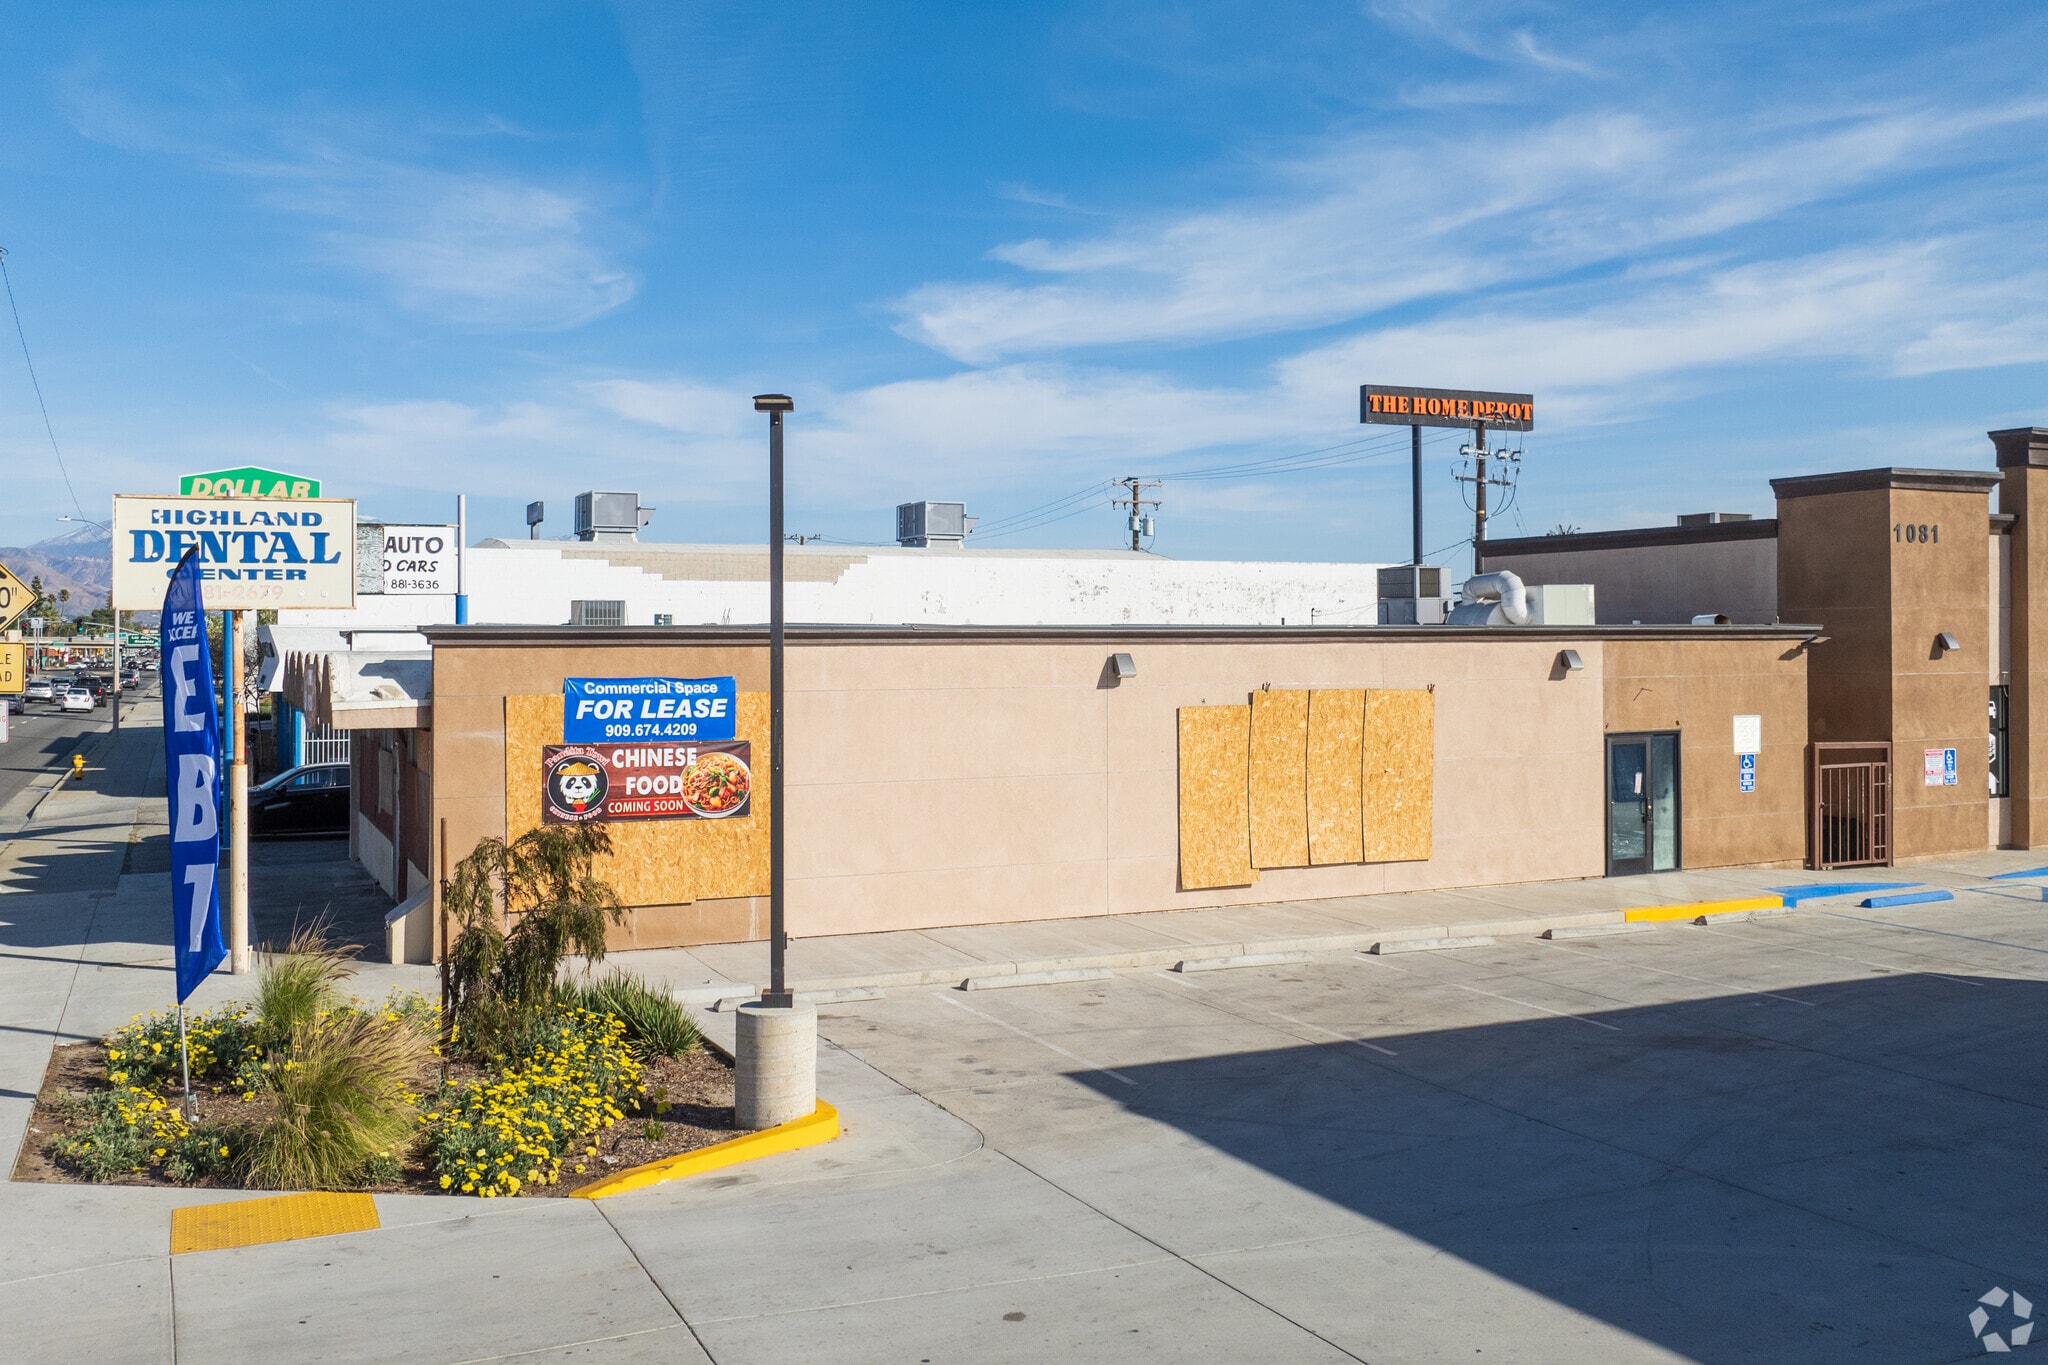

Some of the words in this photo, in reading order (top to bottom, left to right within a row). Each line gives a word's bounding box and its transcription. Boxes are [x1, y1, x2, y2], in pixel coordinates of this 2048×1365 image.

[1369, 394, 1409, 414] THE
[1412, 397, 1469, 417] HOME
[1472, 400, 1533, 421] DEPOT
[190, 477, 311, 498] DOLLAR
[151, 509, 323, 527] HIGHLAND
[1893, 523, 1938, 544] 1081
[128, 529, 342, 564] DENTAL
[384, 536, 444, 554] AUTO
[396, 560, 439, 572] CARS
[391, 579, 439, 589] 881-3636
[172, 611, 195, 625] WE
[584, 681, 671, 694] Commercial
[675, 682, 718, 696] Space
[575, 699, 634, 720] FOR
[640, 698, 728, 719] LEASE
[605, 723, 697, 737] 909.674.4209
[611, 747, 697, 768] CHINESE
[625, 775, 684, 795] FOOD
[608, 801, 651, 813] COMING
[653, 800, 684, 811] SOON
